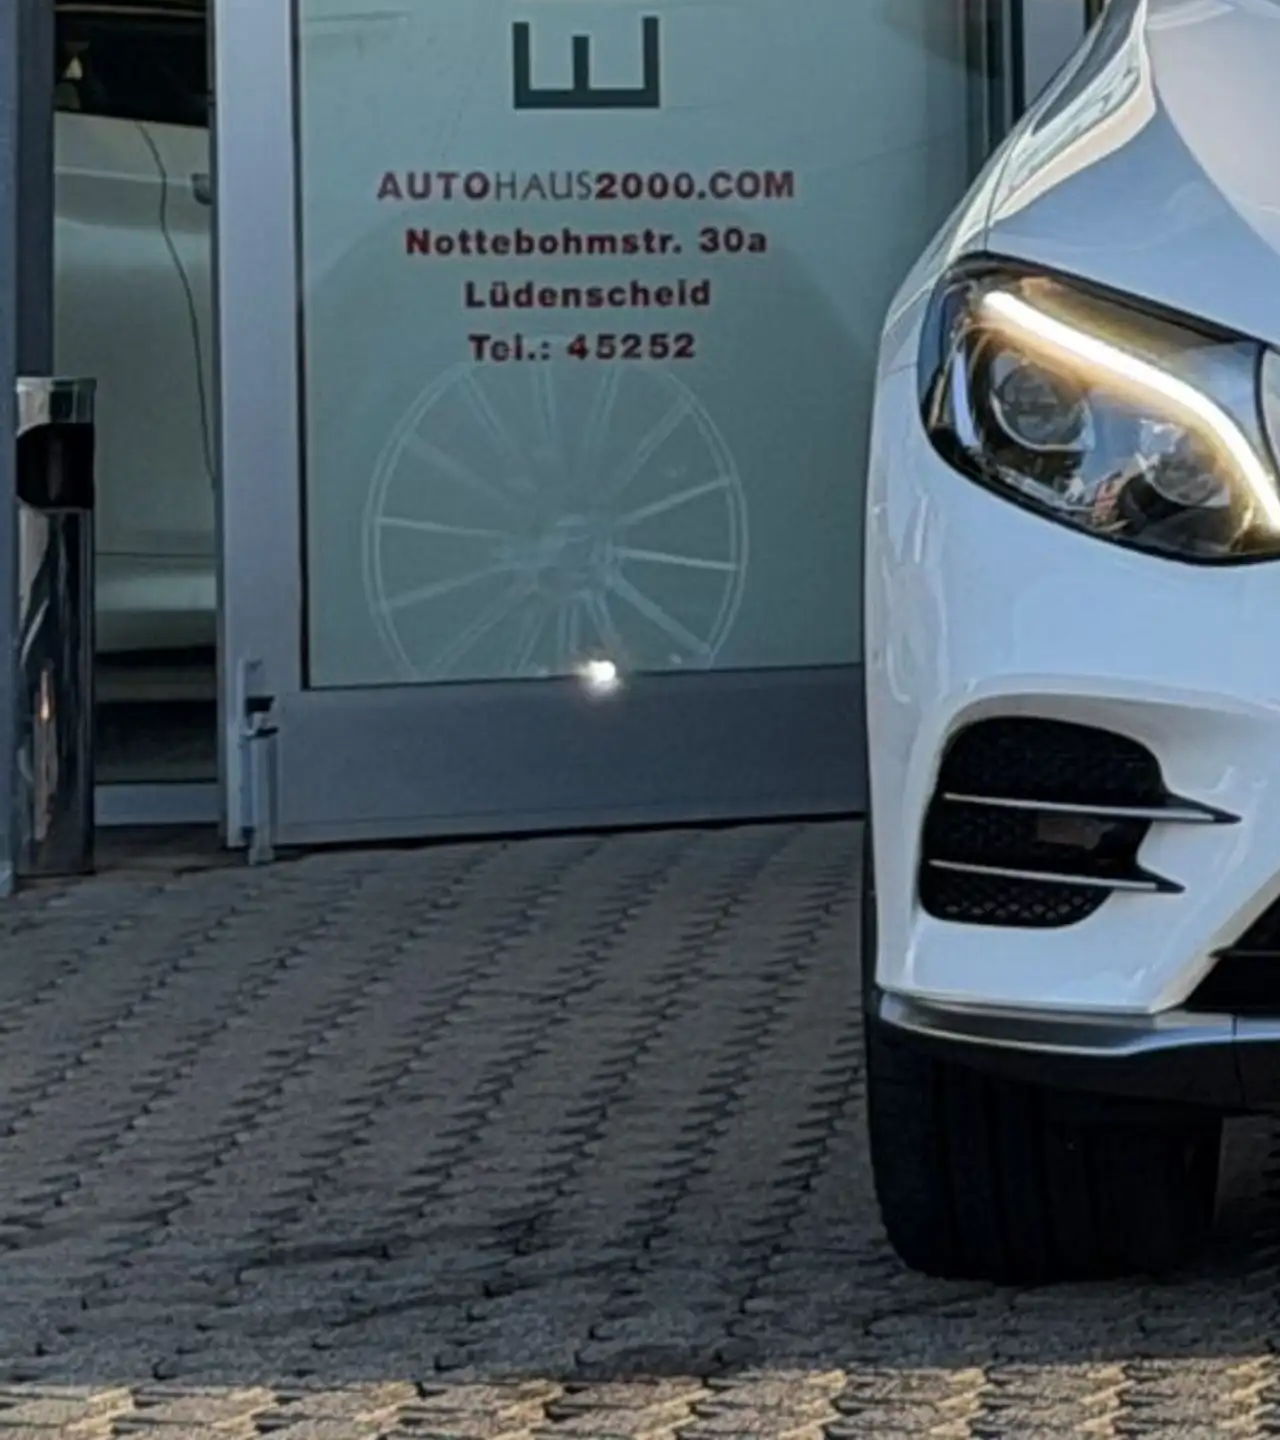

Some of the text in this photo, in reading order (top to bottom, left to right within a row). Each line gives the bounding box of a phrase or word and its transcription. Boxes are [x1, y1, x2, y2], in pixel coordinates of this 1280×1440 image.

[376, 170, 795, 201] AUTOHAUS2000.COM
[405, 227, 767, 256] Nottebohmstr. 30a
[464, 279, 711, 308] Lüdenscheid
[468, 333, 696, 361] Tel.: 45252
